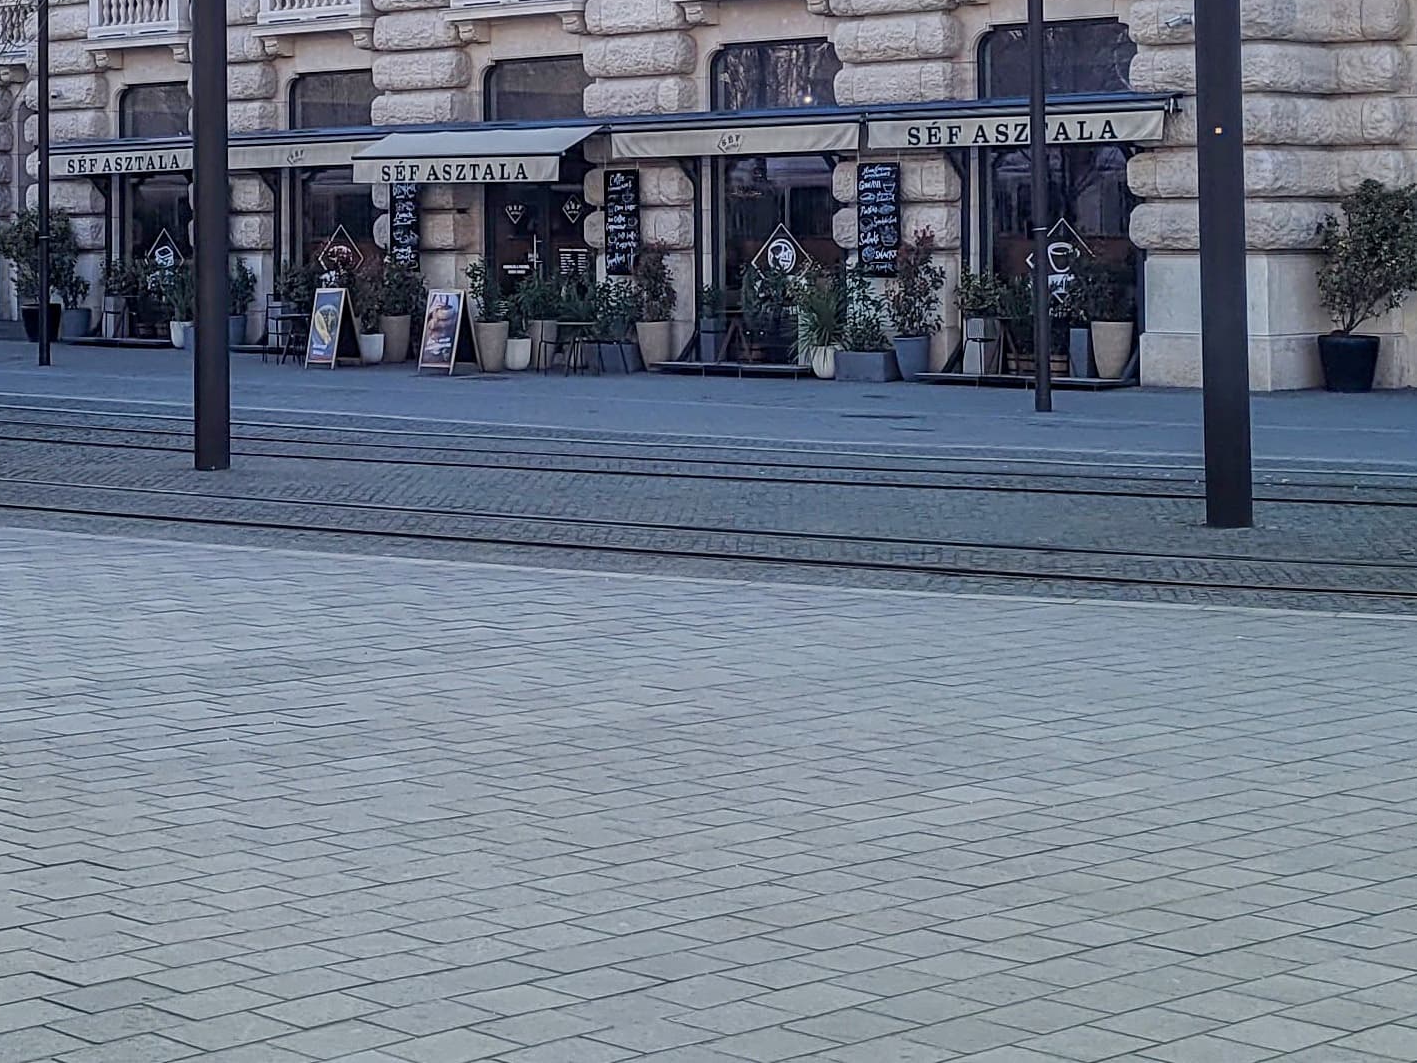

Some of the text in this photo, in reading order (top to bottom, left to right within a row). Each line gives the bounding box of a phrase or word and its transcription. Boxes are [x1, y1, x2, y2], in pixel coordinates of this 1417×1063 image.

[907, 119, 1118, 145] SÉF ASZALA
[67, 154, 180, 173] SÉF ASZTALA
[381, 161, 528, 182] SÉF ASZTALA
